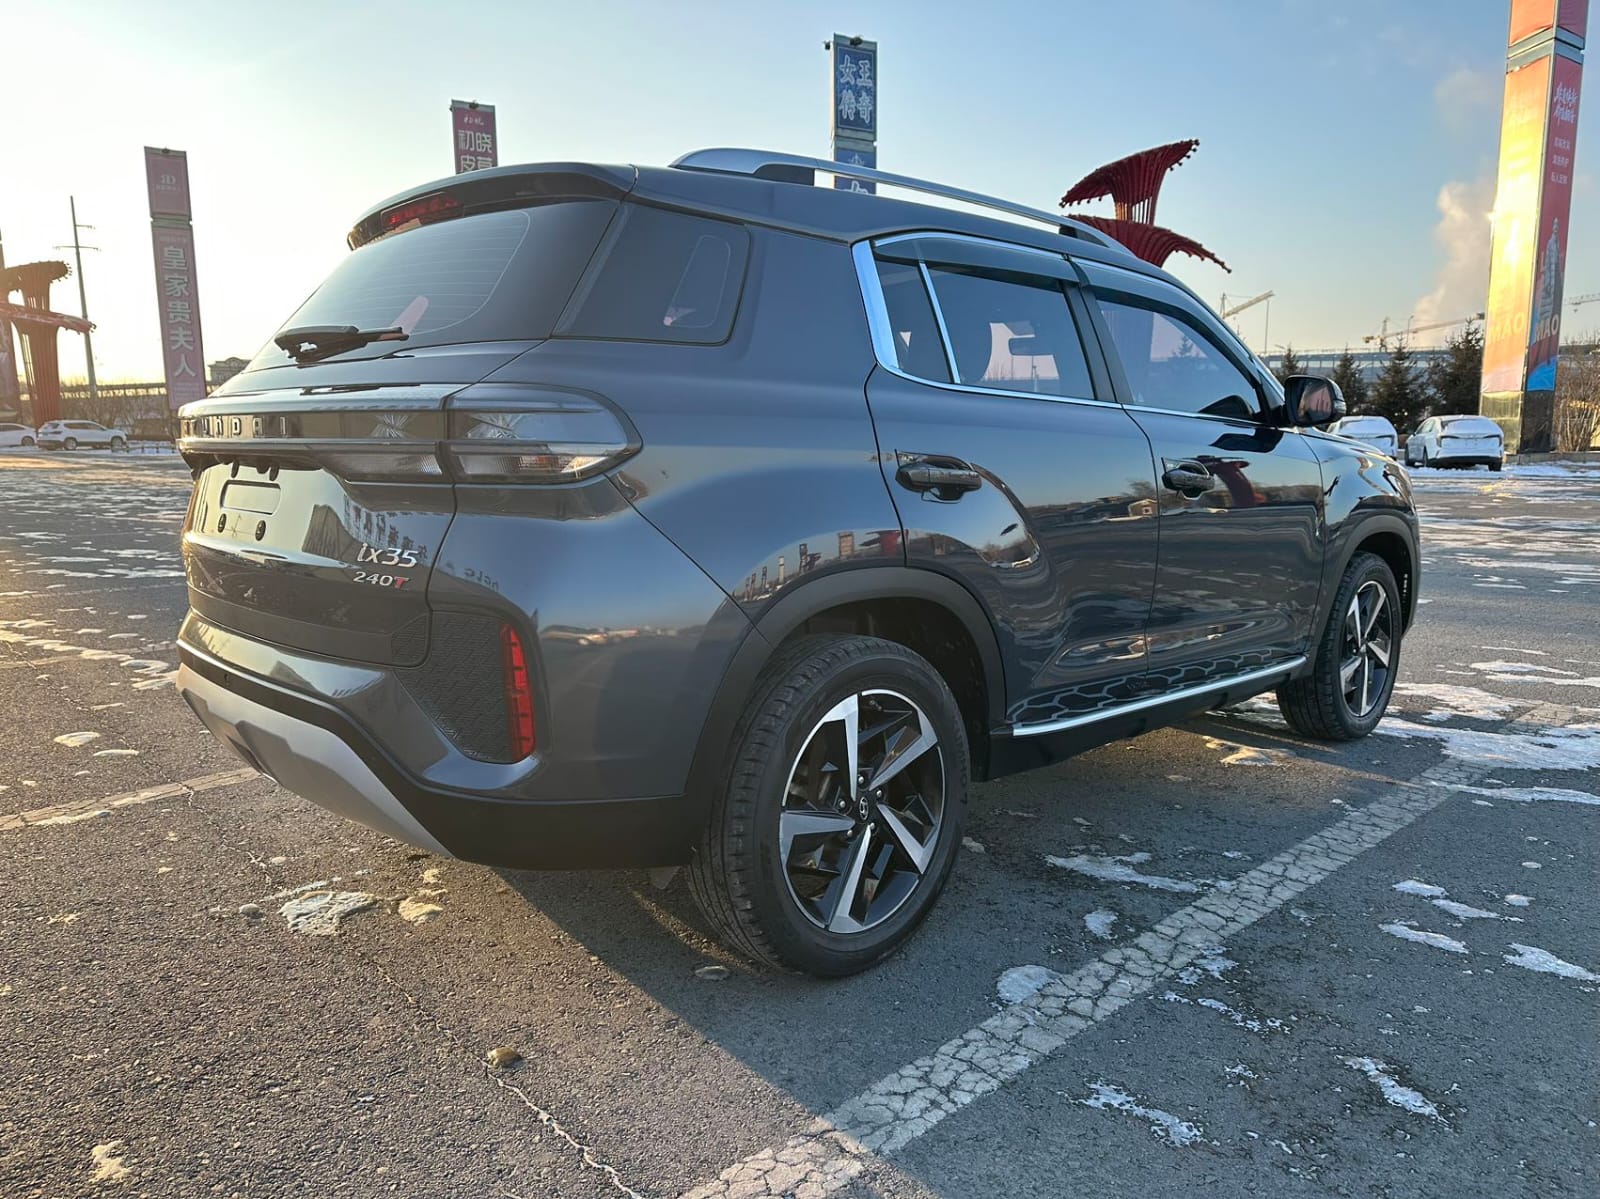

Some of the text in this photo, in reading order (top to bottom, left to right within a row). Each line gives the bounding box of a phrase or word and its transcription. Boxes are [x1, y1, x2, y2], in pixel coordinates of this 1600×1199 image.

[840, 54, 873, 87] 女王
[458, 129, 493, 153] 初晓
[162, 246, 197, 378] 皇家贵夫人
[1534, 314, 1559, 342] MAO
[356, 542, 419, 569] ix35
[353, 571, 410, 589] 240T
